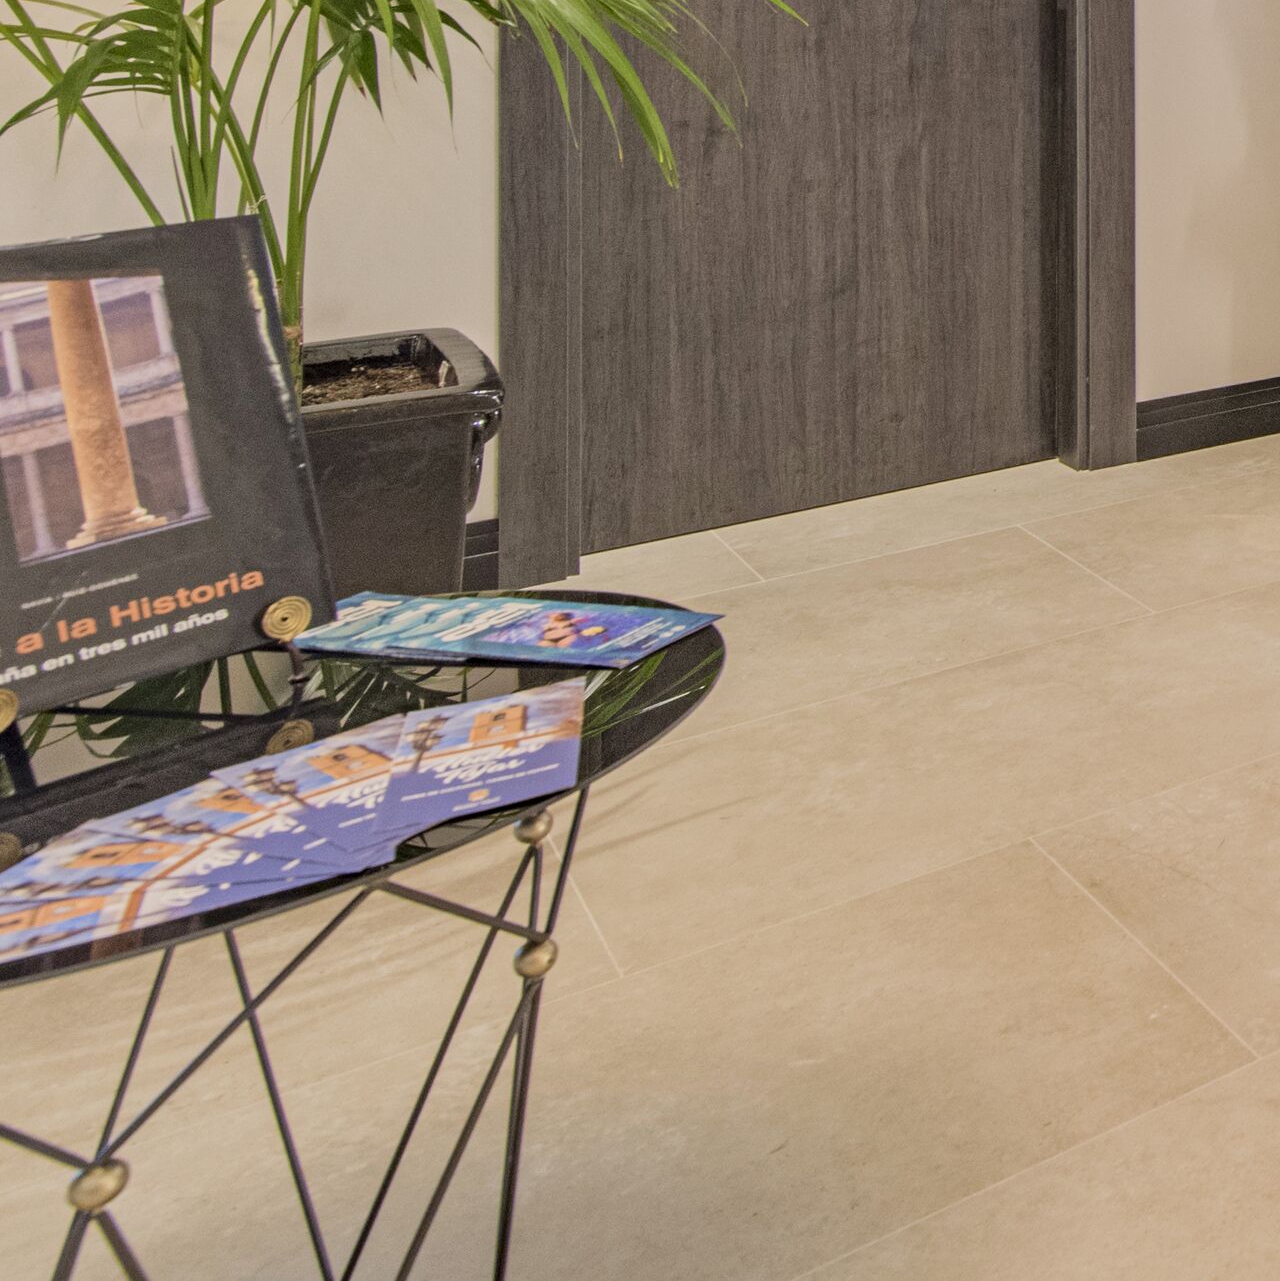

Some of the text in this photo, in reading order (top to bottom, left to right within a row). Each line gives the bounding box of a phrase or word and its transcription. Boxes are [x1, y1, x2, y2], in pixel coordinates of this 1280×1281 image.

[16, 631, 44, 656] a
[56, 617, 97, 643] la
[109, 570, 265, 628] Historia
[40, 653, 75, 671] en
[78, 637, 127, 662] tres
[131, 623, 169, 646] mil
[173, 607, 230, 634] años
